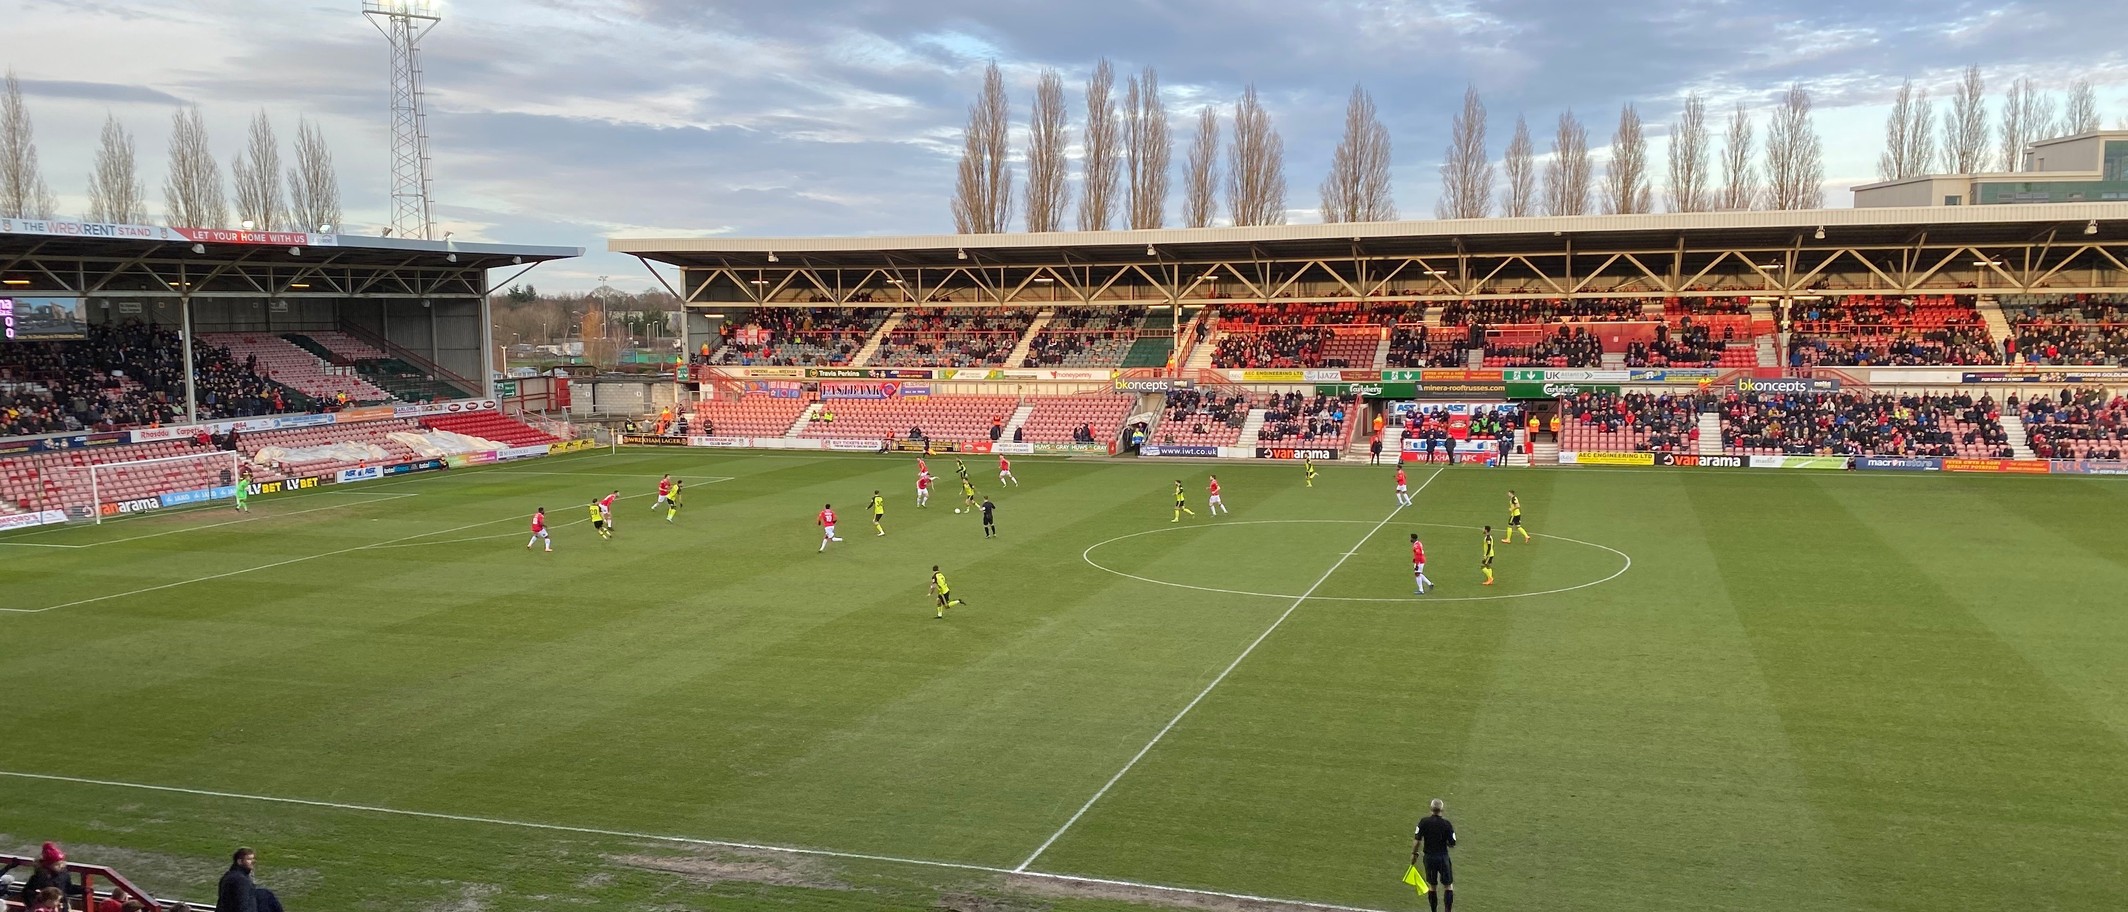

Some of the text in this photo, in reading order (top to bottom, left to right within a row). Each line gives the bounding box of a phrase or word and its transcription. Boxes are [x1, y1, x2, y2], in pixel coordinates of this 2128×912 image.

[22, 221, 151, 237] THE WREXRENT STAND
[192, 231, 209, 239] LET
[213, 231, 237, 241] YOUR
[241, 233, 266, 242] HOME
[269, 234, 292, 243] WITH
[294, 235, 305, 243] US
[1115, 379, 1168, 392] bkoncepts
[1350, 383, 1383, 395] Carlsberg
[1739, 379, 1806, 393] bkoncepts
[1396, 404, 1416, 412] AST
[1447, 404, 1467, 412] AST
[1497, 404, 1517, 412] AST
[141, 430, 169, 439] Rhosddu
[1161, 447, 1217, 456] www.iwt.co.uk
[1461, 453, 1477, 462] AFC
[1675, 455, 1741, 467] vanarama
[2056, 461, 2066, 471] R
[2074, 462, 2084, 472] R
[248, 477, 318, 495] LV BET LV BET
[102, 498, 160, 516] anarama
